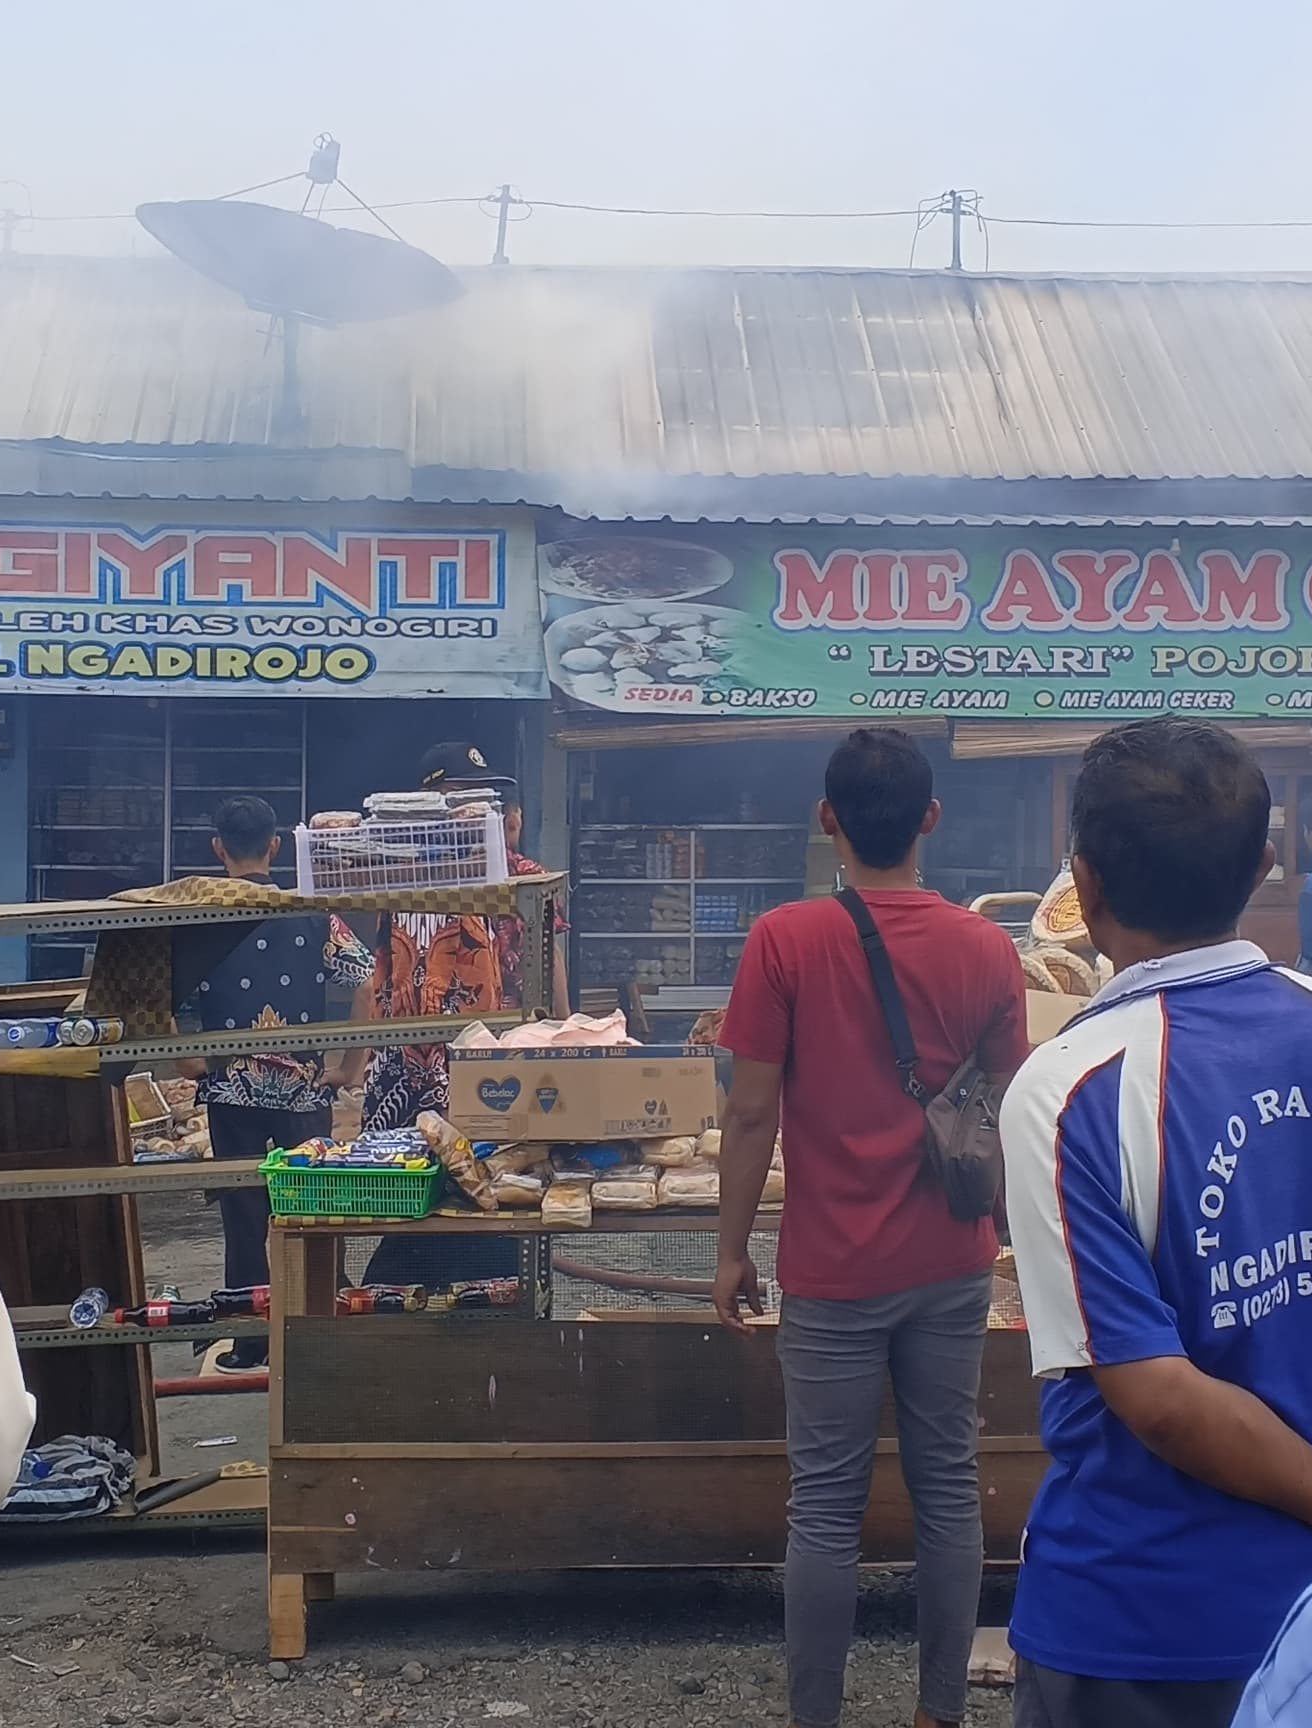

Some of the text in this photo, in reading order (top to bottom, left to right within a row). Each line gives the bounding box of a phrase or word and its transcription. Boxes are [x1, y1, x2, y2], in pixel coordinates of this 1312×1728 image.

[778, 551, 966, 627] MIE
[987, 552, 1287, 629] AYAM
[99, 612, 237, 636] KHAS
[248, 616, 497, 639] WONOGIRI
[25, 641, 372, 681] NGADIROJO
[624, 687, 693, 703] SEDIA
[729, 689, 816, 708] BAKSO
[871, 690, 926, 709] MIE
[931, 690, 1008, 709] AYAM
[1061, 691, 1104, 709] MIE
[1106, 691, 1163, 709] AYAM
[1170, 691, 1234, 709] CEKER
[1195, 1114, 1247, 1257] TOKO
[1242, 1276, 1290, 1328] (0273)
